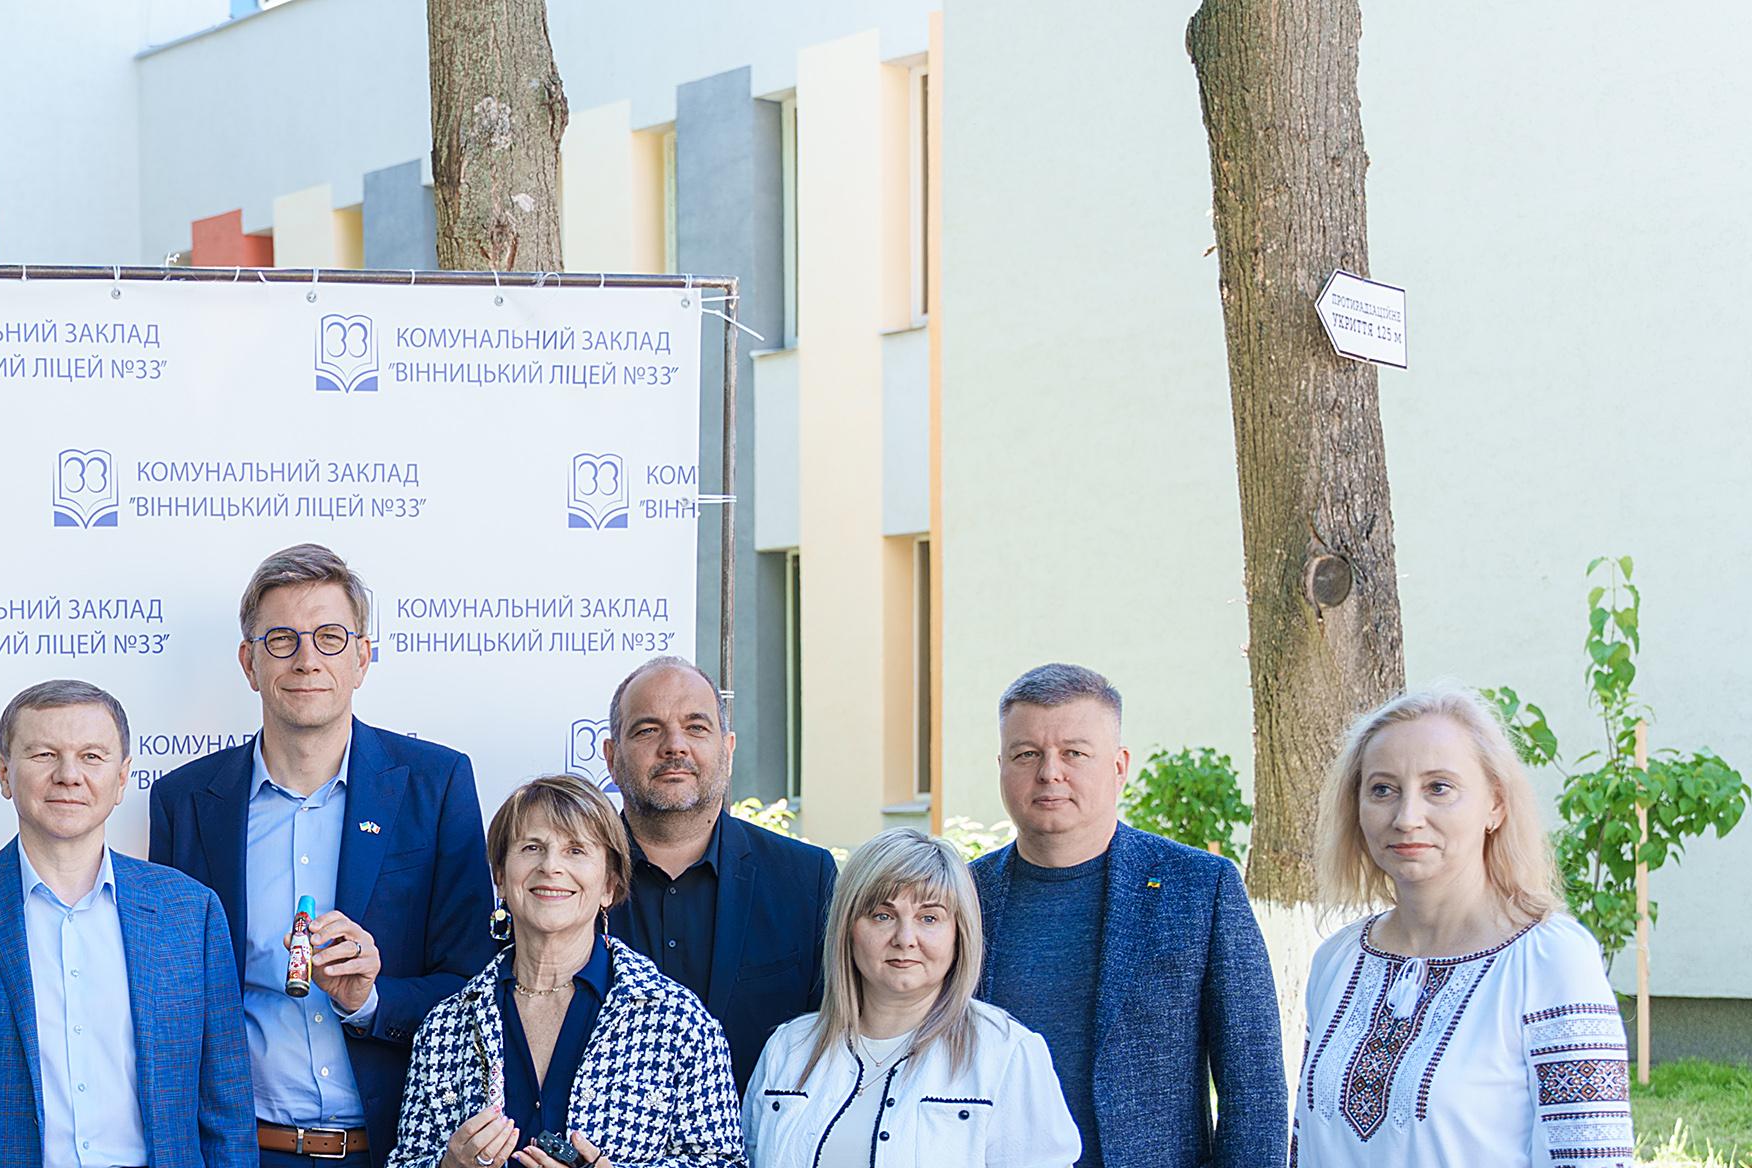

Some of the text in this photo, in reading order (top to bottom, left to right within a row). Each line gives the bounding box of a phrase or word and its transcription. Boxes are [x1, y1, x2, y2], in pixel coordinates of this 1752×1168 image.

[65, 323, 160, 348] ЗАКЛАД
[397, 327, 670, 355] КОМУНАЛЬНИЙ ЗАКЛАД
[32, 354, 102, 382] ЛІЦЕЙ
[112, 359, 167, 379] №33"
[388, 361, 679, 389] "ВІННИЦЬКИЙ ЛІЦЕЙ №33"
[138, 459, 419, 487] КОМУНАЛЬНИЙ ЗАКЛАД
[647, 465, 697, 485] КОМ
[129, 493, 426, 521] "ВІННИЦЬКИЙ ЛІЦЕЙ №33"
[639, 499, 696, 518] "ВІНН
[68, 599, 163, 623] ЗАКЛАД
[398, 595, 668, 622] КОМУНАЛЬНИЙ ЗАКЛАД
[35, 630, 105, 659] ЛІЦЕЙ
[114, 634, 170, 655] №33"
[389, 629, 675, 656] "ВІННИЦЬКИЙ ЛІЦЕЙ №33"
